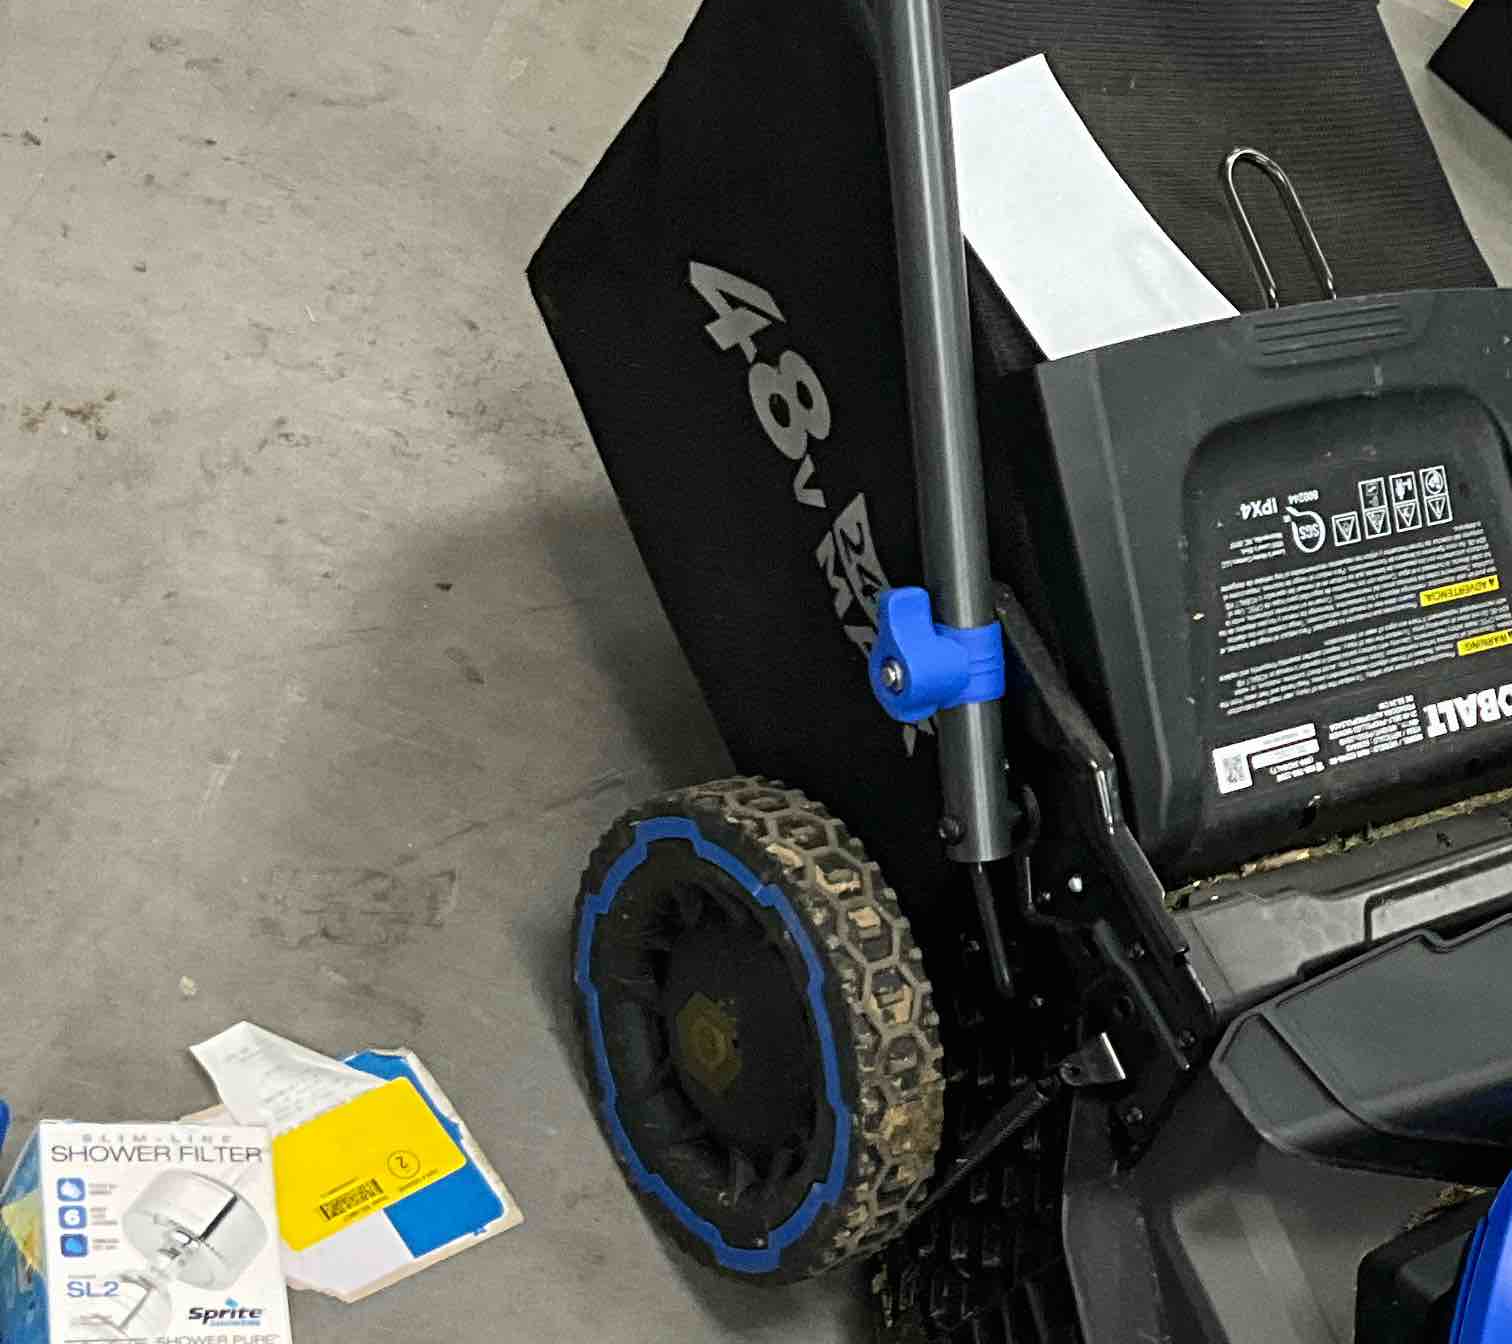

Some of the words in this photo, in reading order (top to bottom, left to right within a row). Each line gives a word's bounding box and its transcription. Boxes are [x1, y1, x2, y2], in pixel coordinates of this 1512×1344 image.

[1239, 497, 1278, 520] IPX4
[1298, 522, 1319, 540] SGS
[1463, 634, 1507, 651] WARNING
[51, 1145, 171, 1163] SHOWER
[179, 1146, 263, 1163] FILTER
[64, 1209, 80, 1225] 6
[67, 1281, 119, 1298] SL2
[188, 1305, 263, 1325] Sprite
